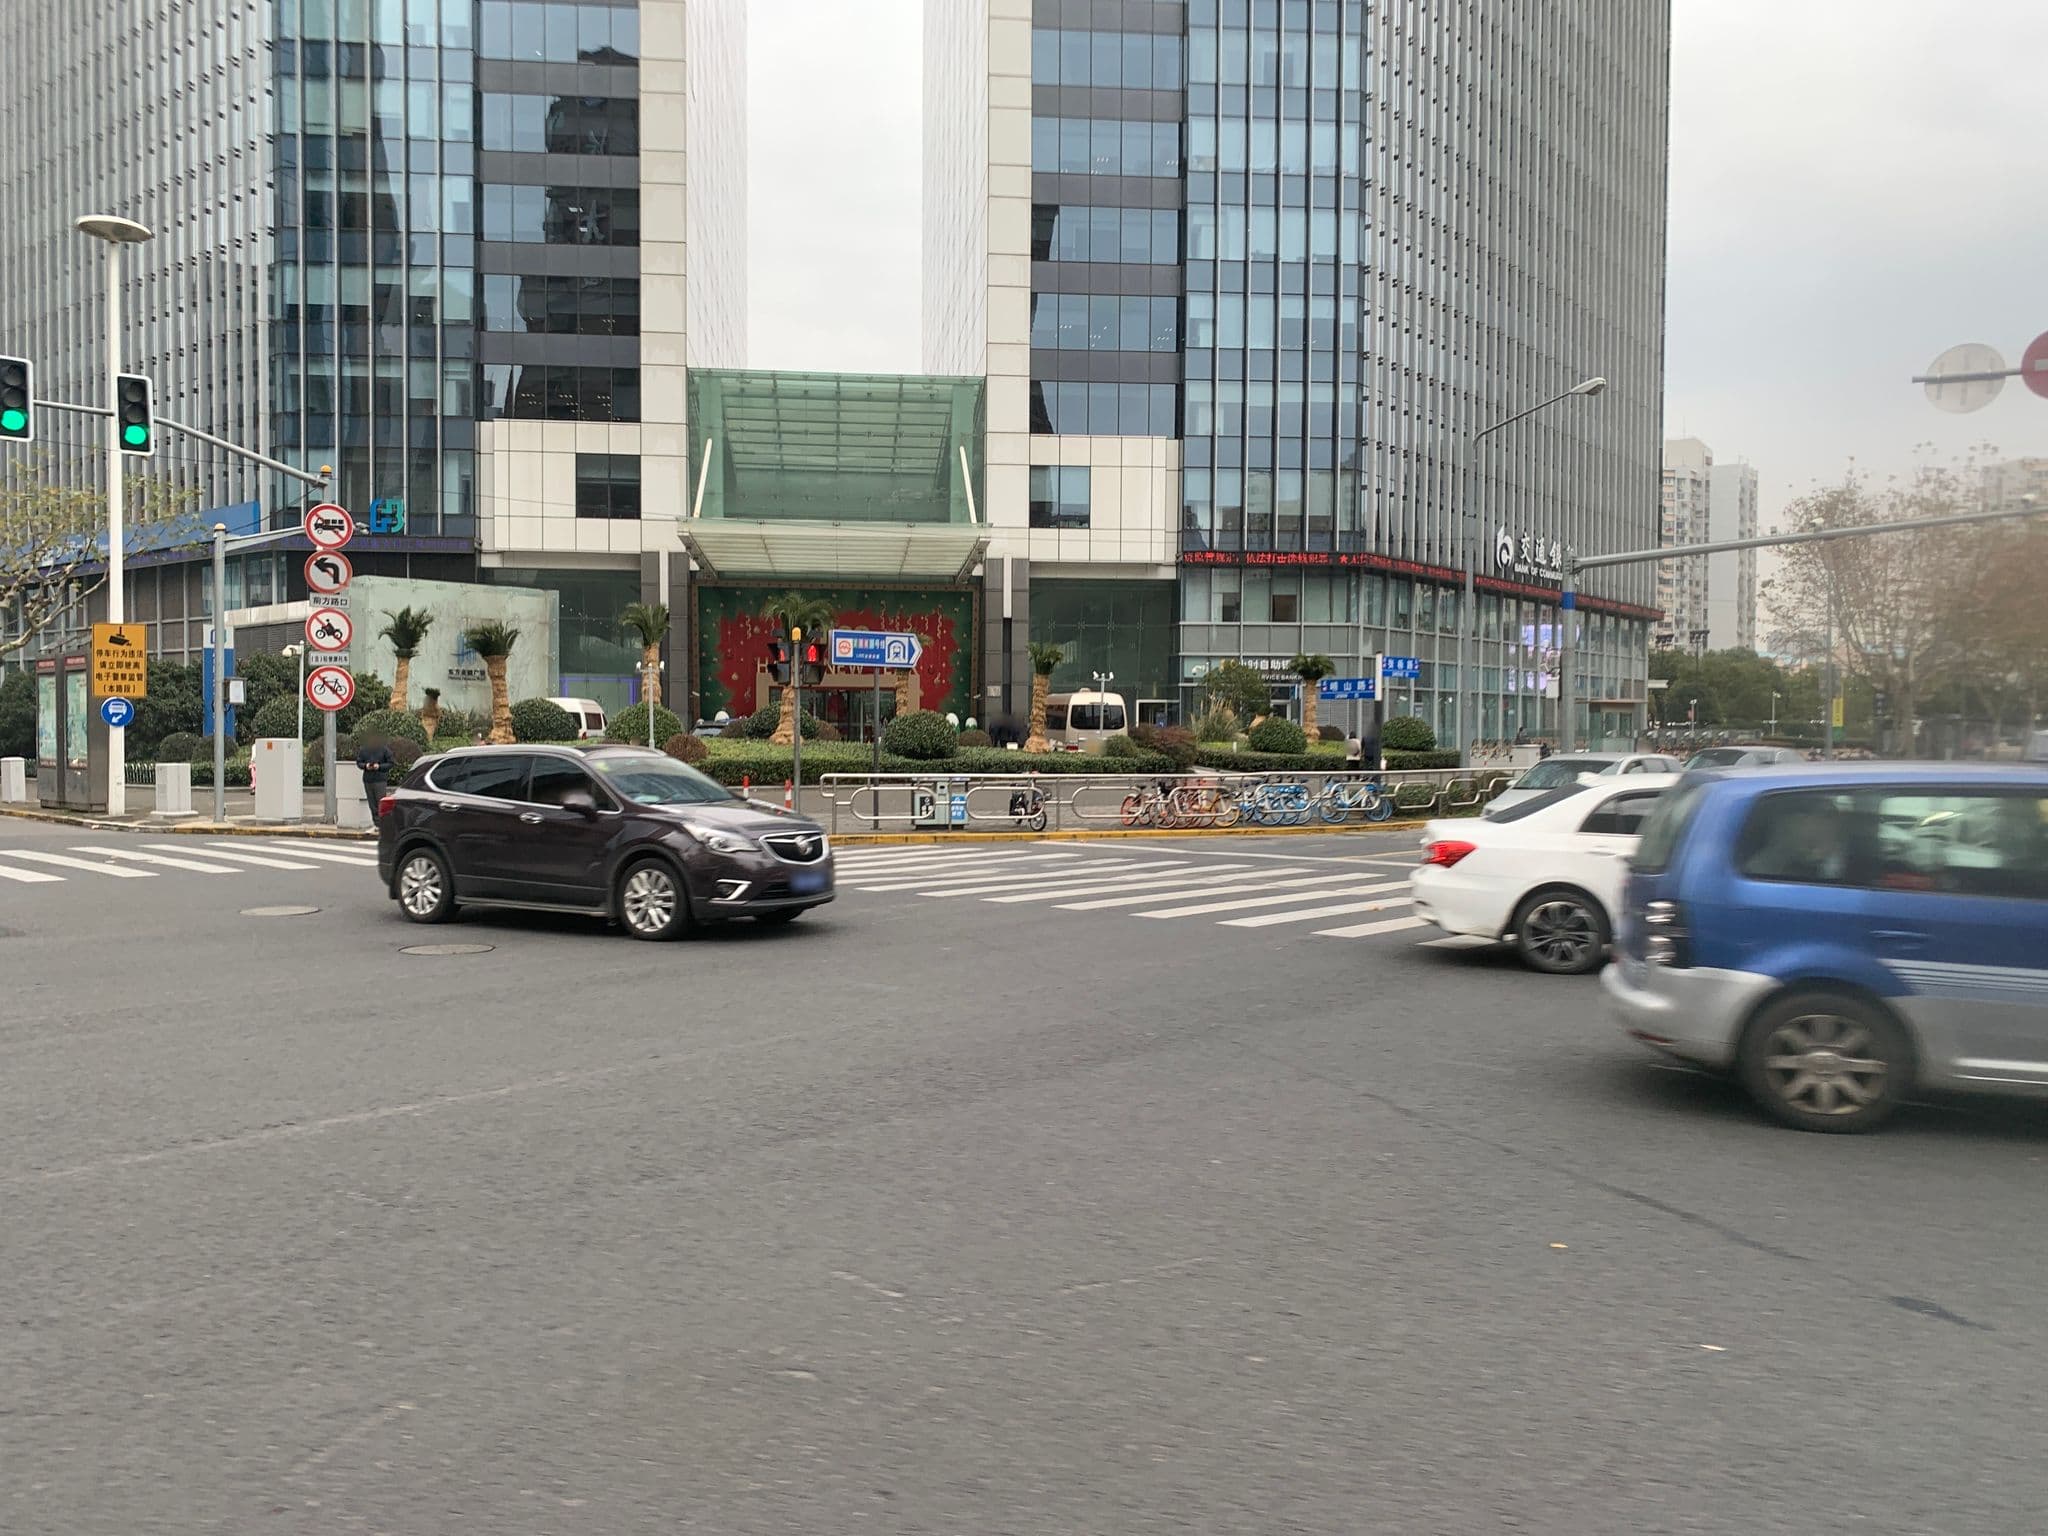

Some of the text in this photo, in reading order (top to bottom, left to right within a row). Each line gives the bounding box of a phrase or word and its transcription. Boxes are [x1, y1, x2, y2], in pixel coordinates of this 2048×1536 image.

[313, 596, 348, 606] 前方路口
[96, 649, 143, 658] 停车行为违法
[99, 661, 141, 670] 请立即驶离
